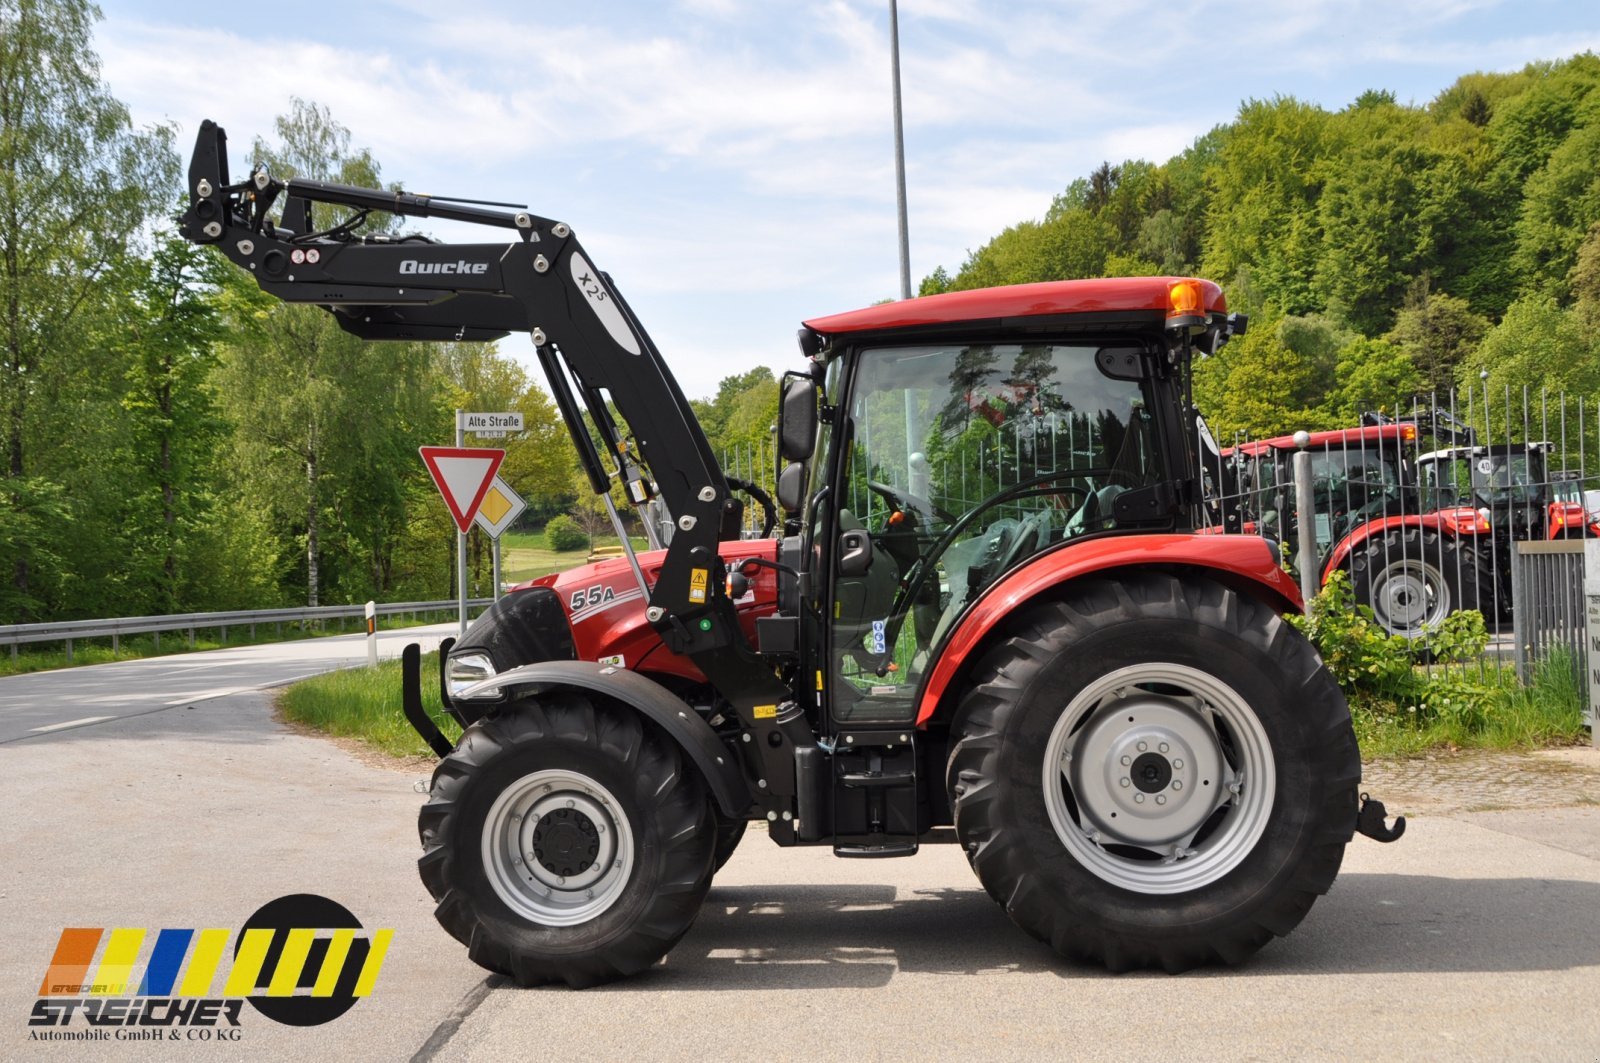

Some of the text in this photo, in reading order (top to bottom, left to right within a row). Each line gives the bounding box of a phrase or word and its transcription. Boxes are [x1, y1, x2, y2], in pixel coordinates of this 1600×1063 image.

[399, 259, 489, 274] Quicke
[468, 416, 519, 427] Alte Straße
[570, 584, 615, 611] 55A
